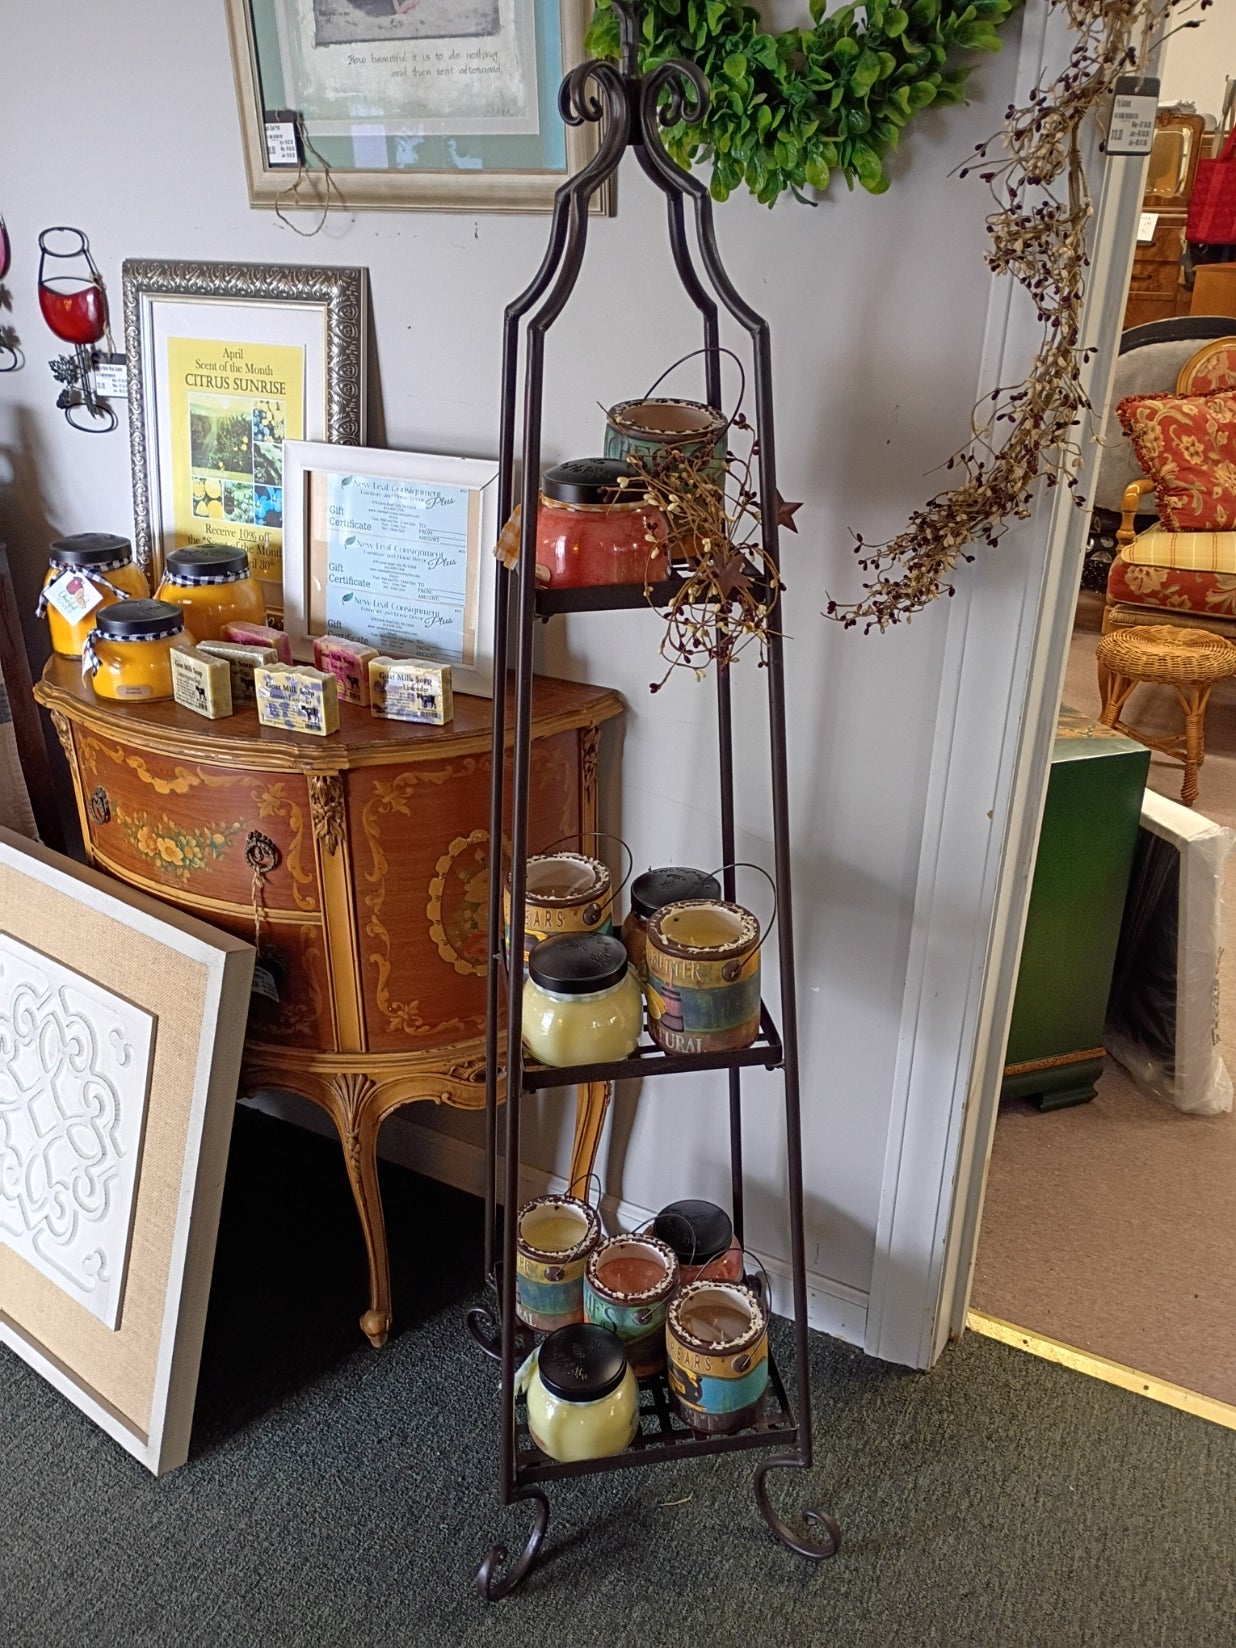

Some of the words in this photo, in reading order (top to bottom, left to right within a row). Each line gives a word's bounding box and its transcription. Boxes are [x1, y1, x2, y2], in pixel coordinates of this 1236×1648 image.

[435, 52, 444, 60] to
[412, 66, 432, 77] then
[222, 347, 244, 360] April
[195, 359, 217, 371] Scent
[219, 361, 229, 372] of
[229, 362, 243, 373] the
[245, 363, 273, 376] Month
[185, 373, 230, 390] CITRUS
[233, 377, 286, 395] SUNRISE
[354, 480, 369, 489] New
[425, 496, 455, 510] Plus
[329, 505, 344, 515] Gift
[329, 517, 372, 531] Certificate
[205, 523, 236, 537] Receive
[239, 528, 257, 541] 10%
[258, 532, 271, 541] off
[187, 534, 199, 545] the
[357, 540, 373, 550] New
[328, 562, 344, 573] Gift
[427, 556, 456, 570] Plus
[328, 574, 371, 588] Certificate
[354, 597, 370, 605] New
[327, 619, 343, 629] Gift
[424, 615, 453, 628] Plus
[379, 671, 395, 680] Goat
[397, 674, 413, 682] Milk
[265, 681, 281, 691] Goat
[283, 684, 297, 693] Milk
[299, 686, 315, 699] Soap
